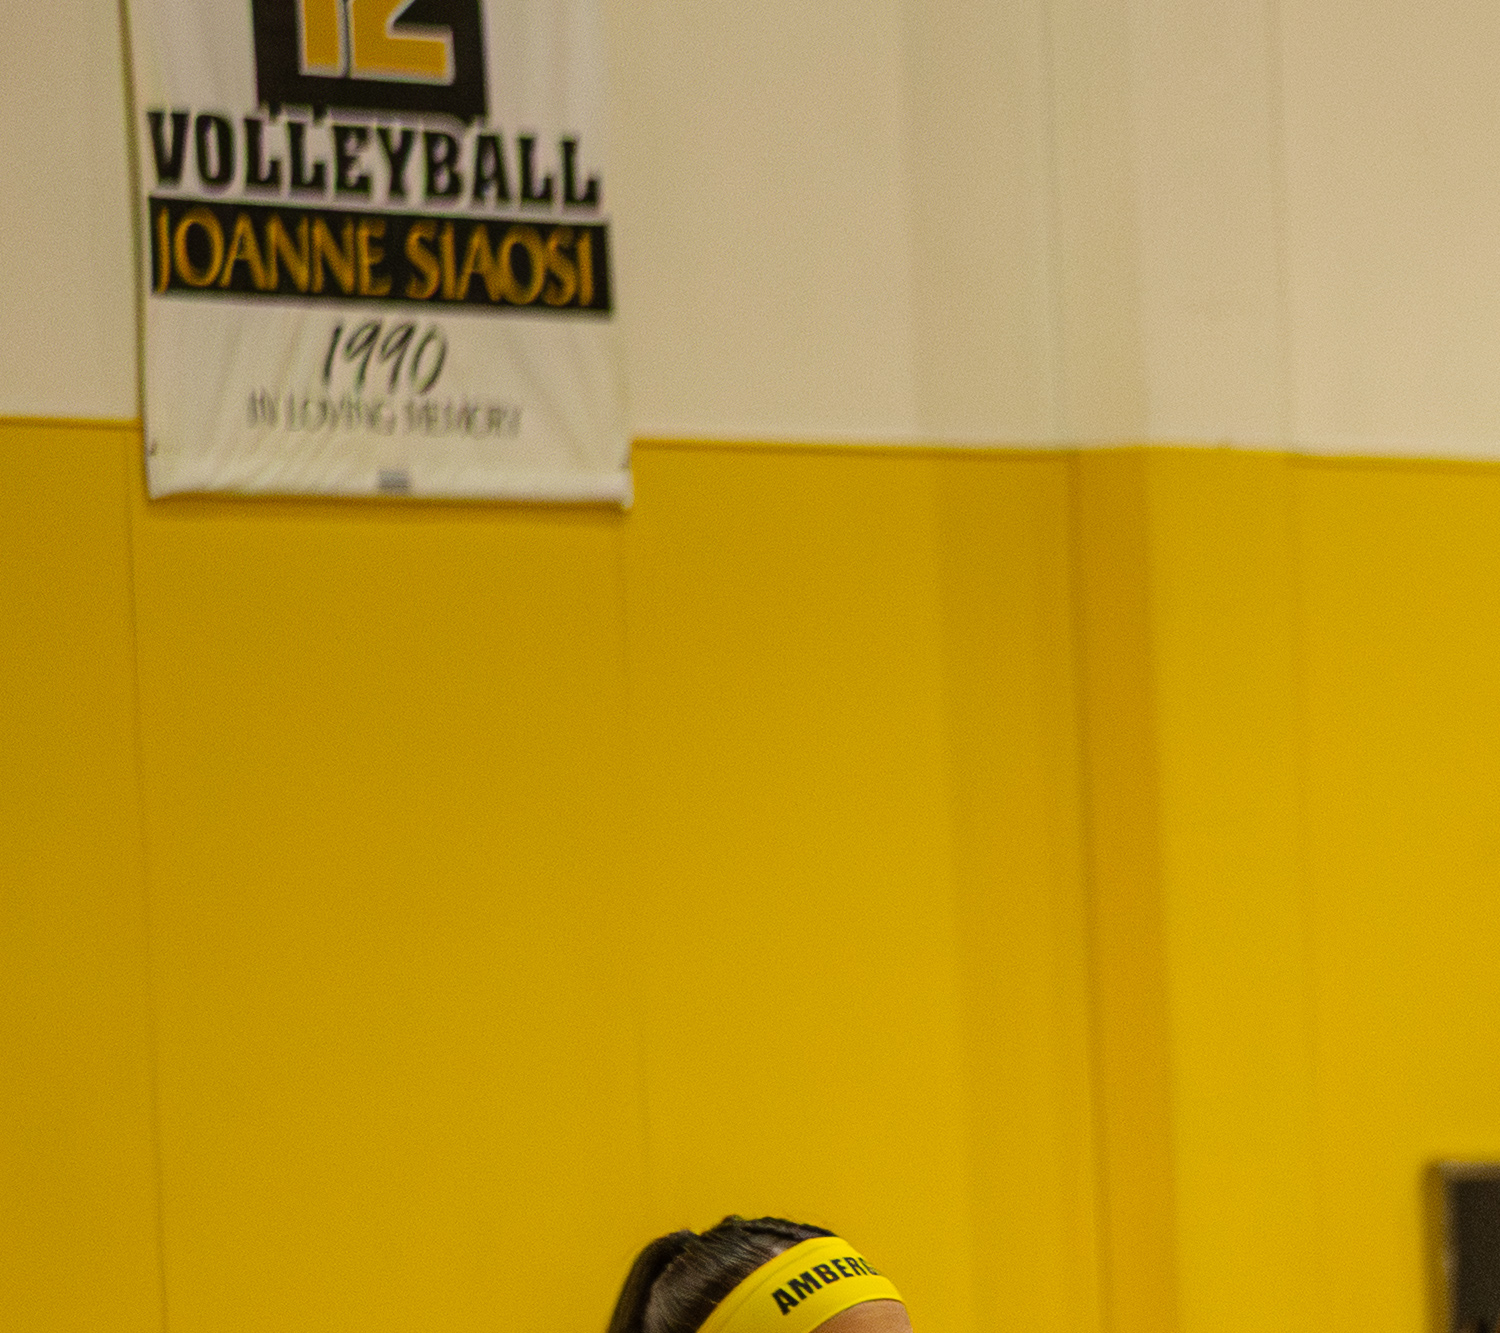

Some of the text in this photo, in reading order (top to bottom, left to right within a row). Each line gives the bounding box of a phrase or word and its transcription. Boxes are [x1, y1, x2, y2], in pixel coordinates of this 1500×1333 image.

[147, 109, 602, 207] VOLLEYBALL
[156, 207, 594, 307] JOANNE SIAOSI
[321, 319, 448, 396] 1990
